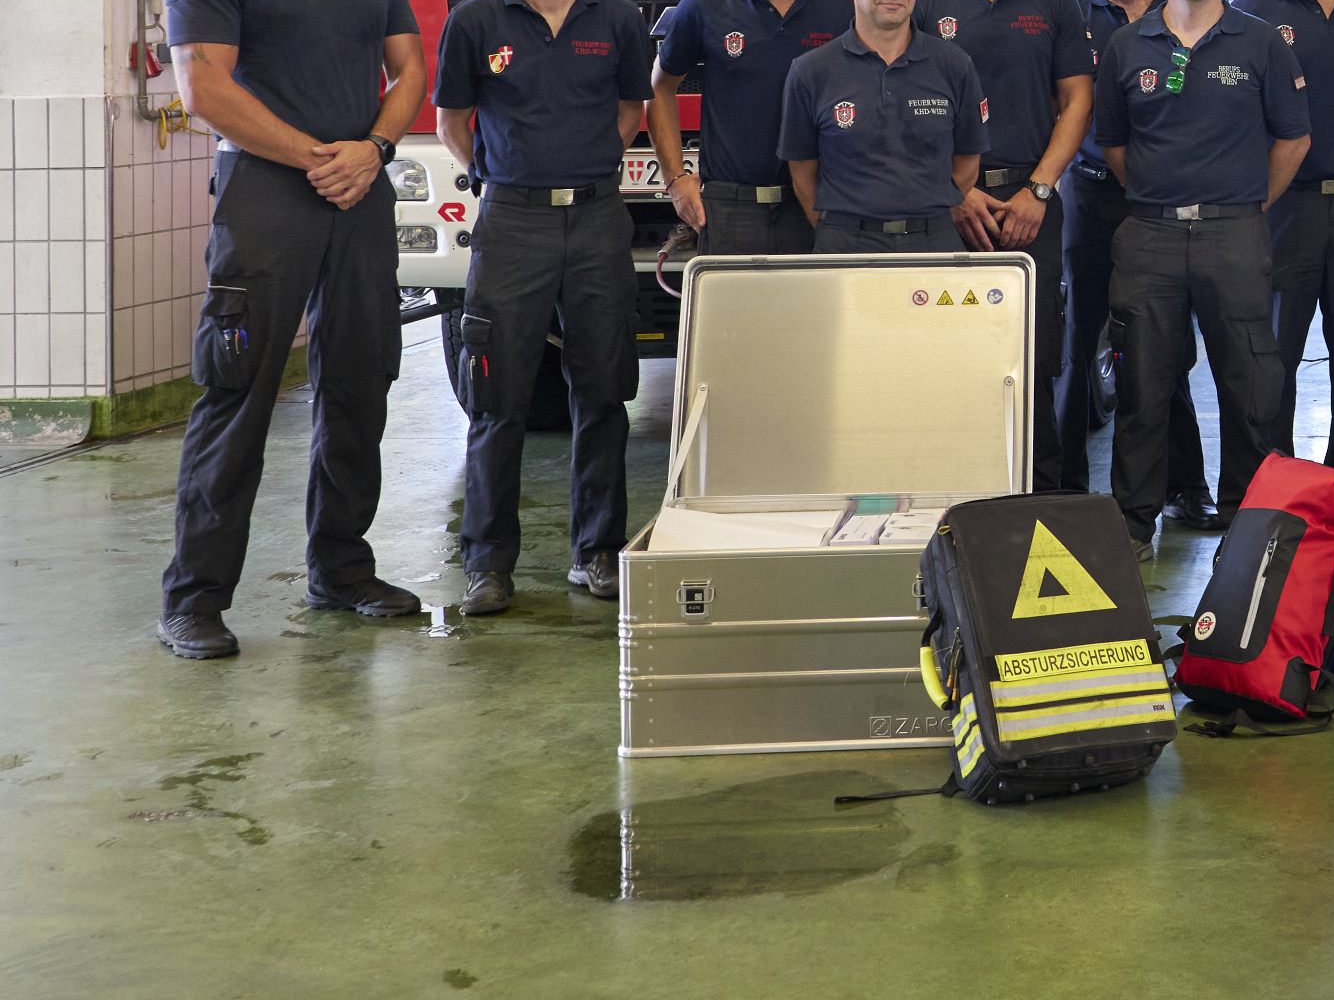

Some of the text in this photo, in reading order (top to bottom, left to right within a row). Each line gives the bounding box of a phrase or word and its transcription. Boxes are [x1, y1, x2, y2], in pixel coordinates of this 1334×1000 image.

[1218, 65, 1241, 73] BERUFS
[1207, 71, 1250, 81] FEUERWEHR
[1220, 78, 1238, 86] WIEN
[908, 99, 949, 107] FEUERWEHR
[1003, 644, 1145, 677] ABSTURZSICHERUNG
[895, 716, 954, 735] ZARG
